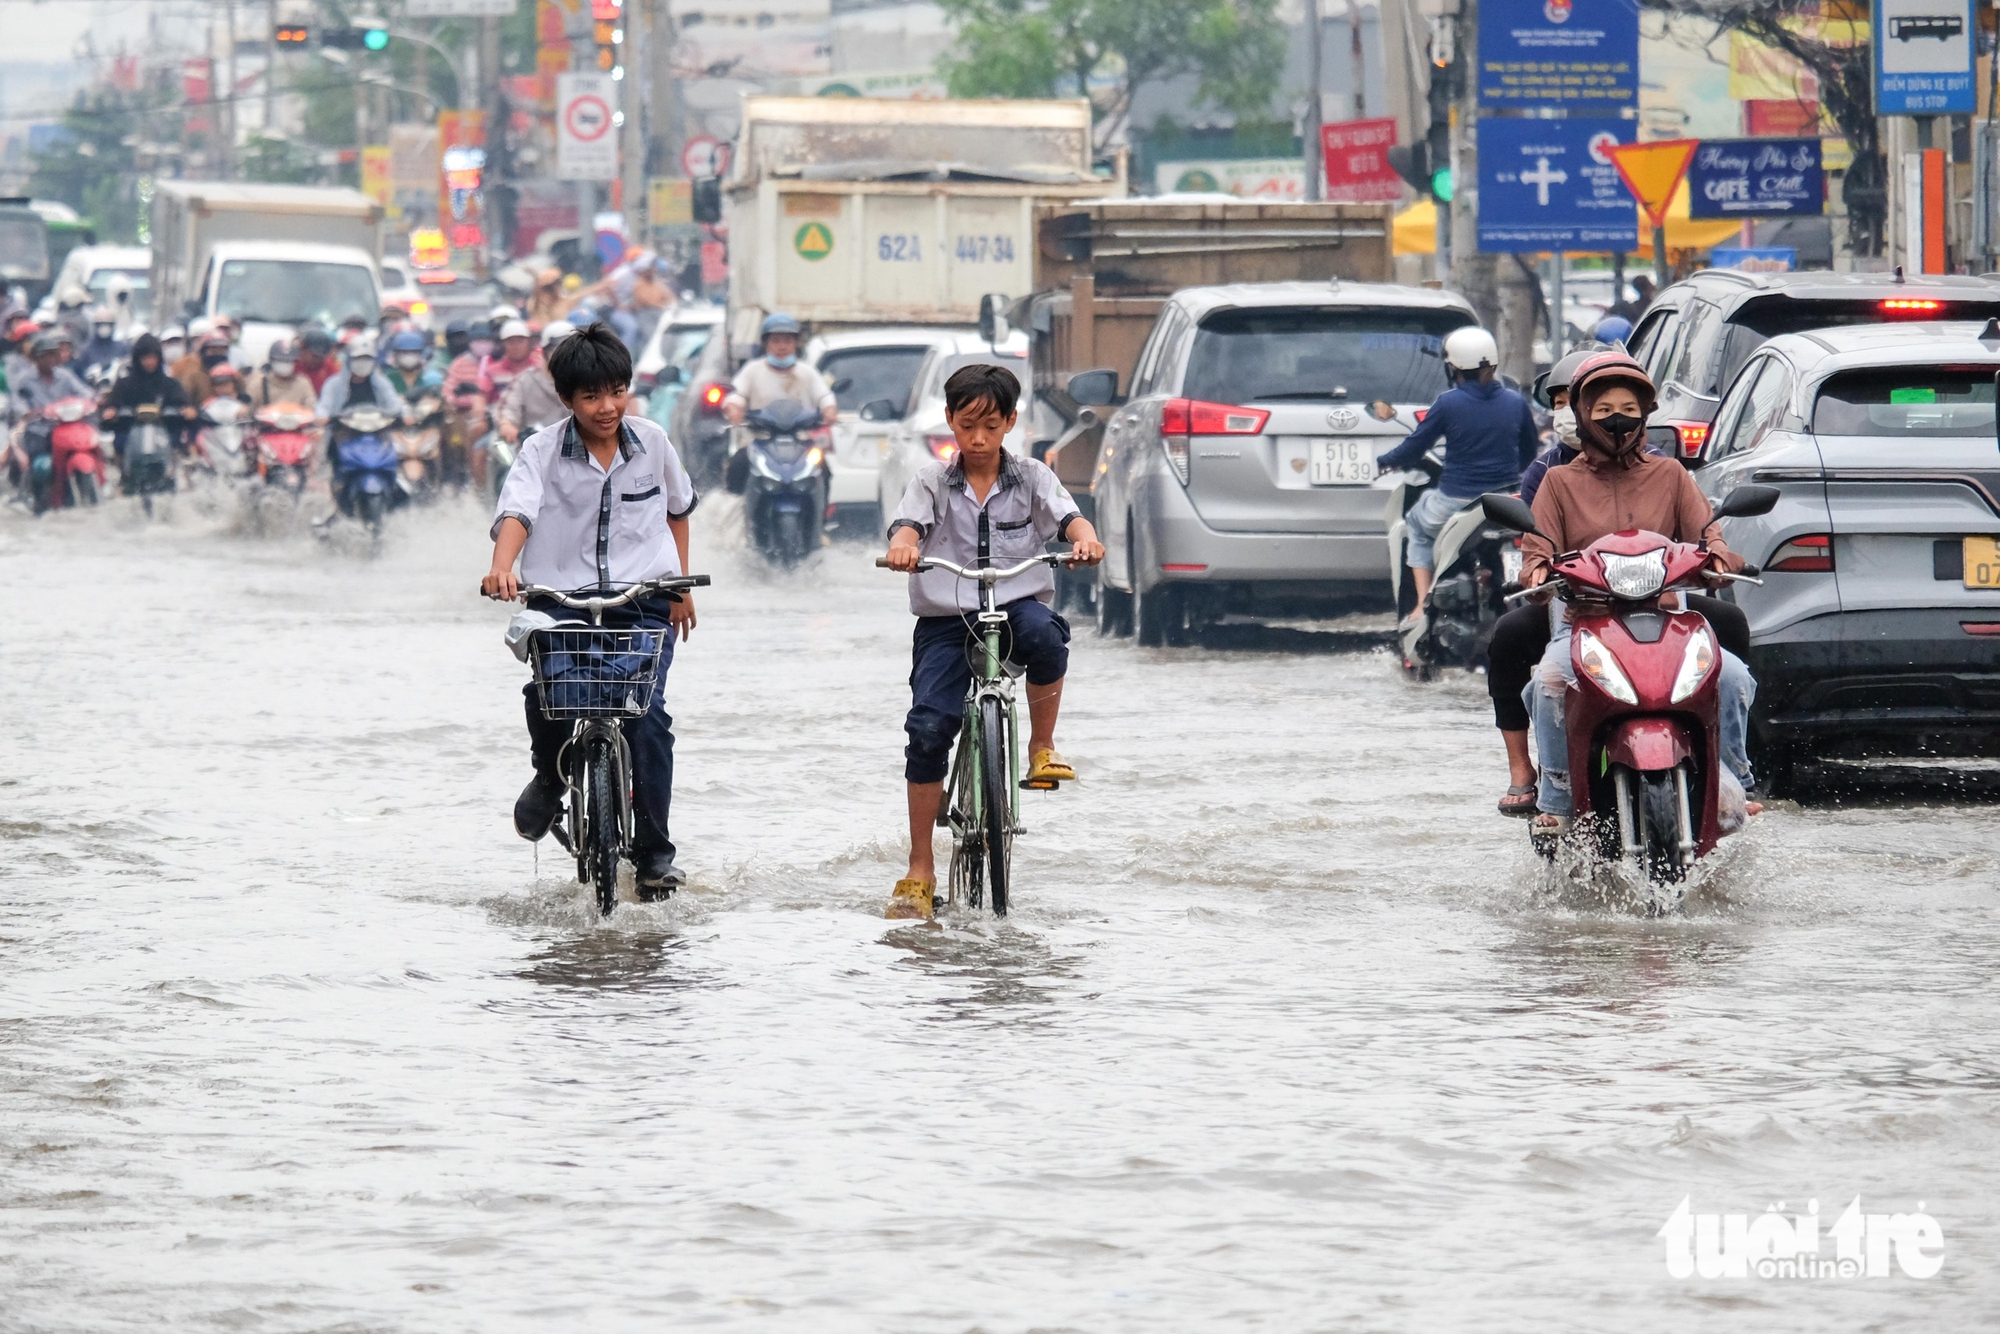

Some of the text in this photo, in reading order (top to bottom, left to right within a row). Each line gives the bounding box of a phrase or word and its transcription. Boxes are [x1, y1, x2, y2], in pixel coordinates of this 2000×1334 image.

[1933, 78, 1945, 91] XE
[1905, 95, 1948, 108] BUS STOP
[1326, 443, 1358, 461] 51G
